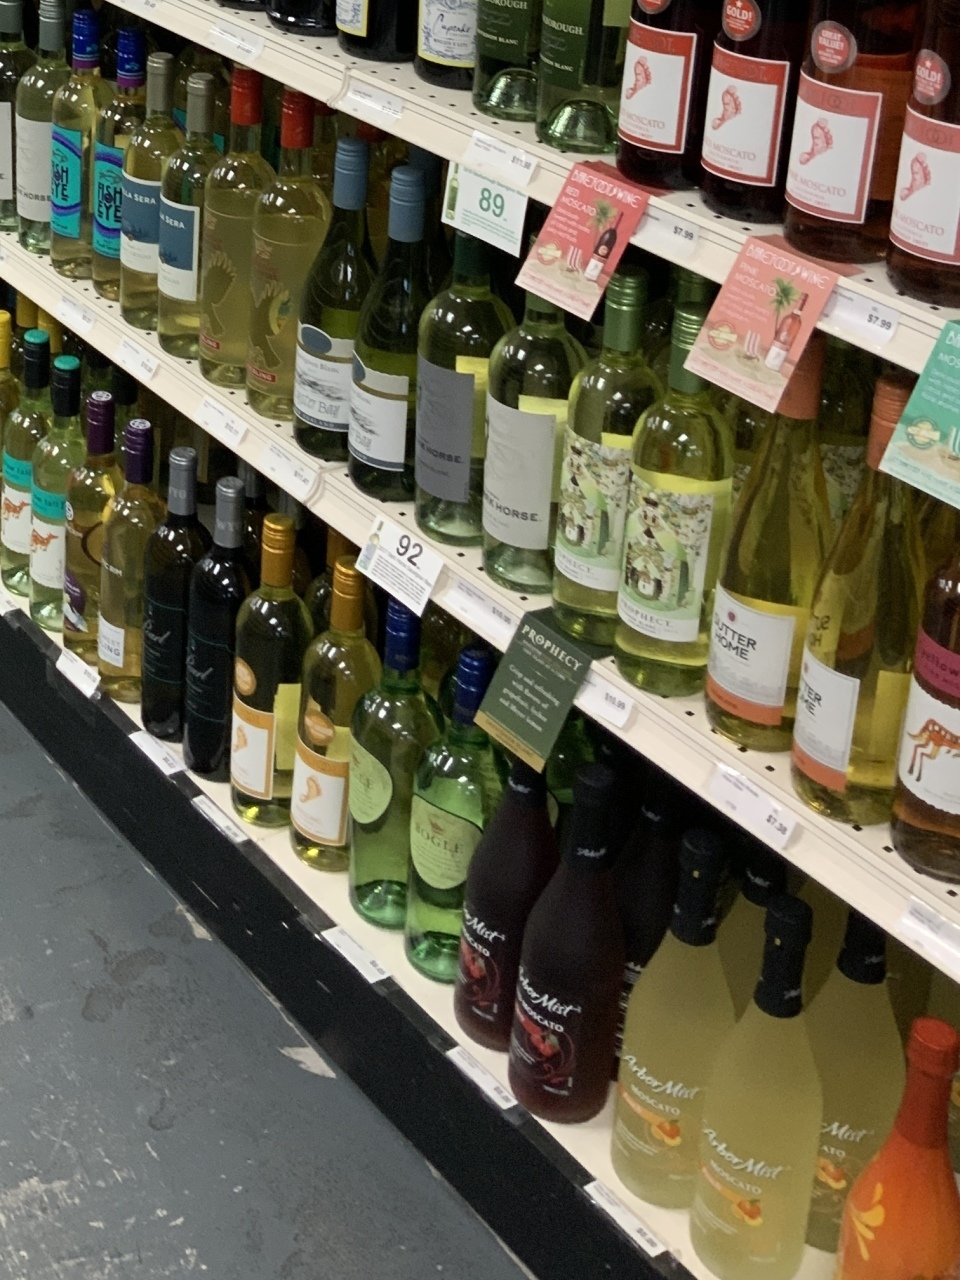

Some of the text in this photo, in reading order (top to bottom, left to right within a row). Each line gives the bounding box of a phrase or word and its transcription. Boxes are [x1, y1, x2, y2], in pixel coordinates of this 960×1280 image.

[433, 13, 471, 36] Cupcake
[726, 5, 752, 21] GOLD!
[713, 142, 757, 161] MOSCATO
[801, 177, 848, 198] MOSCATO
[134, 194, 156, 205] SERA
[478, 187, 505, 217] 89
[165, 216, 185, 229] SERA
[673, 225, 695, 240] $7.99
[866, 313, 893, 331] $7.99
[496, 503, 539, 522] HORSE
[396, 534, 423, 566] 92
[521, 624, 584, 671] PROPHECY
[715, 632, 749, 660] HOME
[471, 916, 503, 943] Mist
[538, 992, 577, 1018] Mist
[624, 1054, 700, 1100] Arbor Mist
[703, 1126, 784, 1180] Arbor Mist
